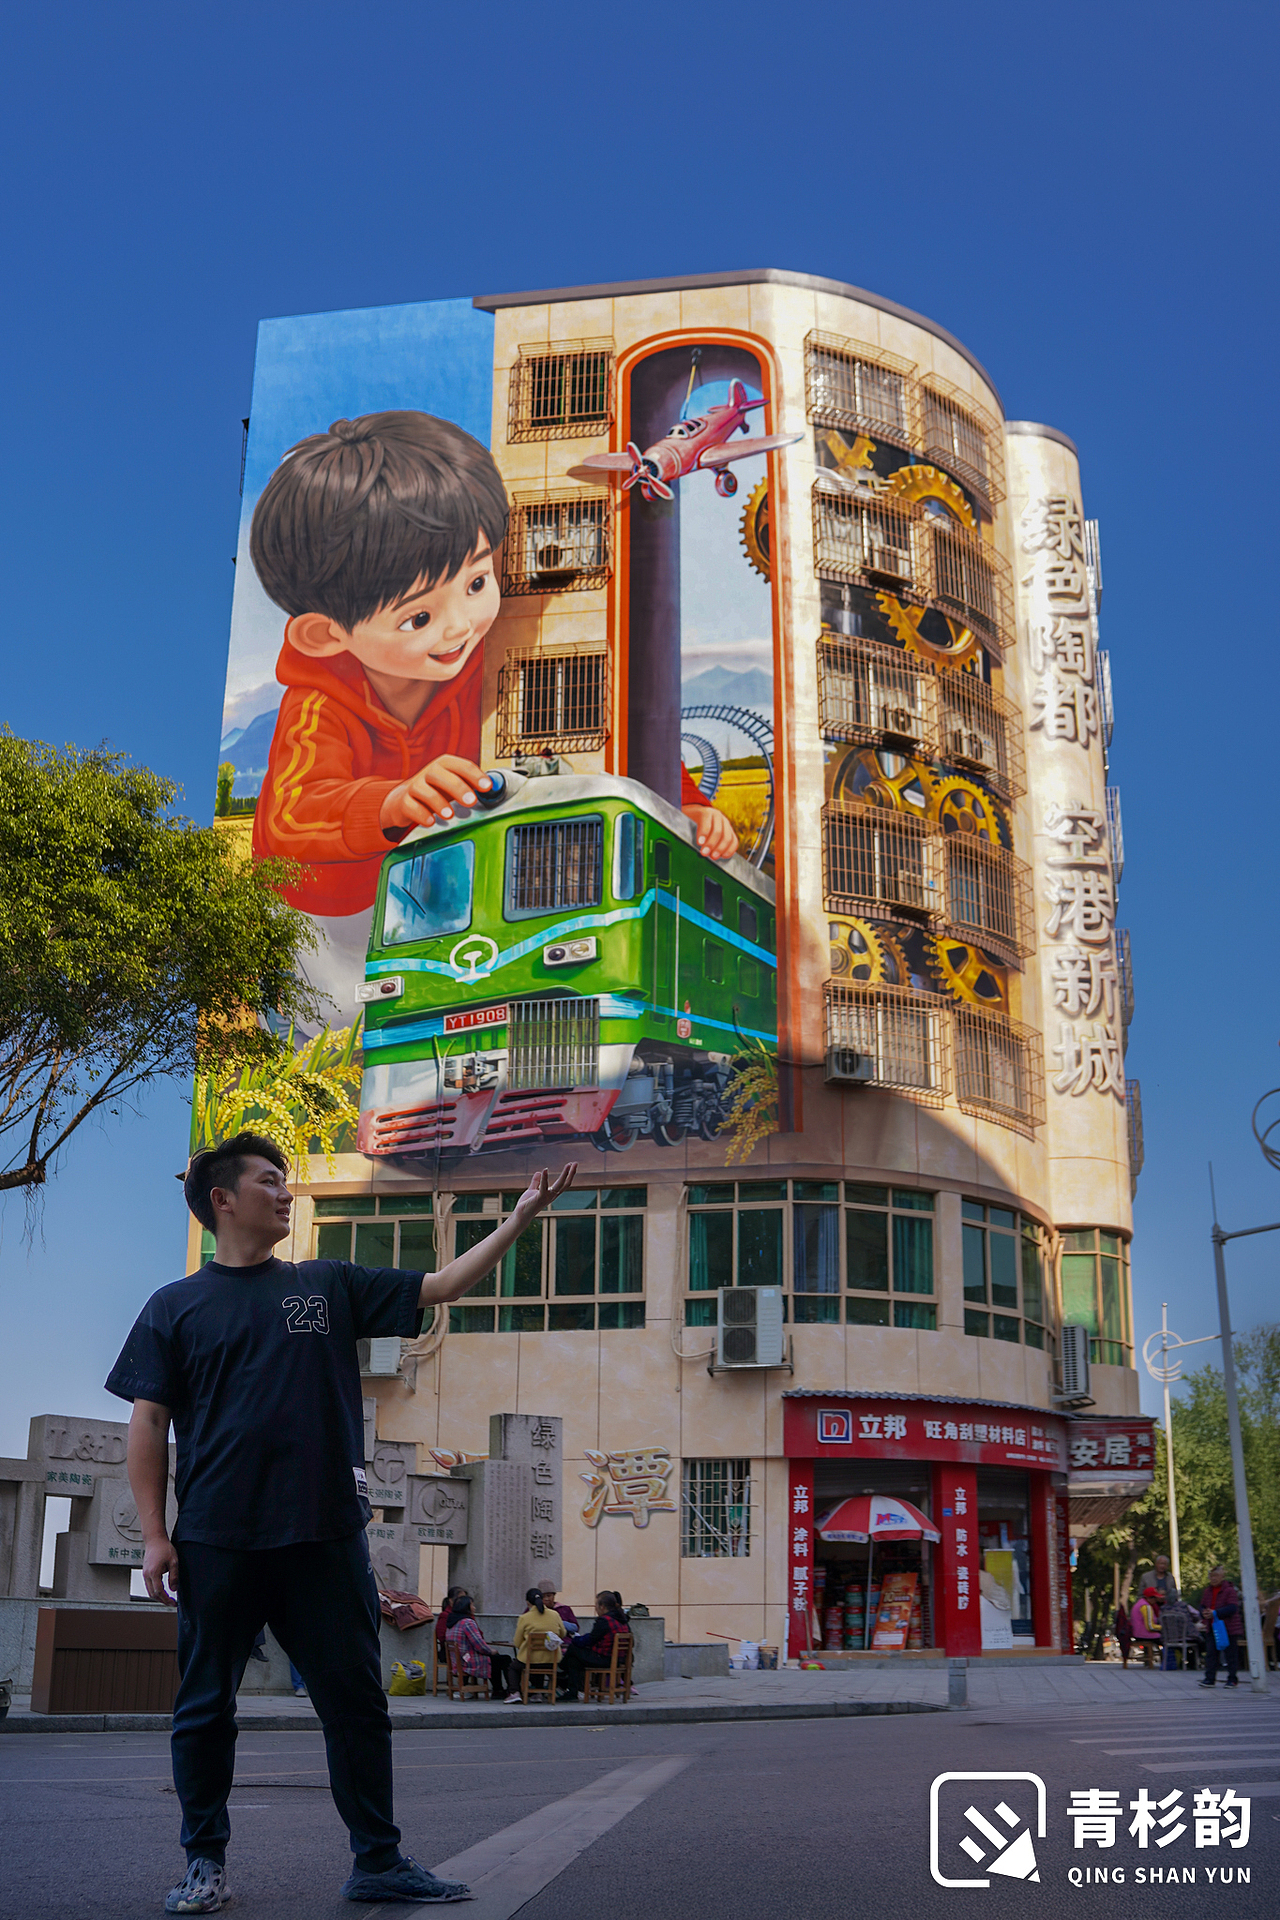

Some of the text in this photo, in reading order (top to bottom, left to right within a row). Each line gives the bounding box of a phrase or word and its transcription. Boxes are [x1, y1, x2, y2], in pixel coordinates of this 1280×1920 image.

[1020, 494, 1126, 1099] 绿色陶都 空港新城
[281, 1295, 330, 1335] 23
[858, 1413, 908, 1440] 立邦
[48, 1427, 128, 1465] L&D
[1070, 1434, 1132, 1468] 安居
[1136, 1432, 1152, 1468] 地产
[46, 1471, 92, 1486] 家美陶瓷
[530, 1421, 556, 1560] 绿色陶都
[578, 1446, 678, 1529] 潭
[793, 1484, 809, 1514] 立邦
[954, 1487, 967, 1516] 立邦
[418, 1528, 454, 1540] 欧雅陶瓷
[793, 1527, 809, 1557] 涂料
[955, 1528, 968, 1557] 防水
[108, 1547, 146, 1560] 新中源
